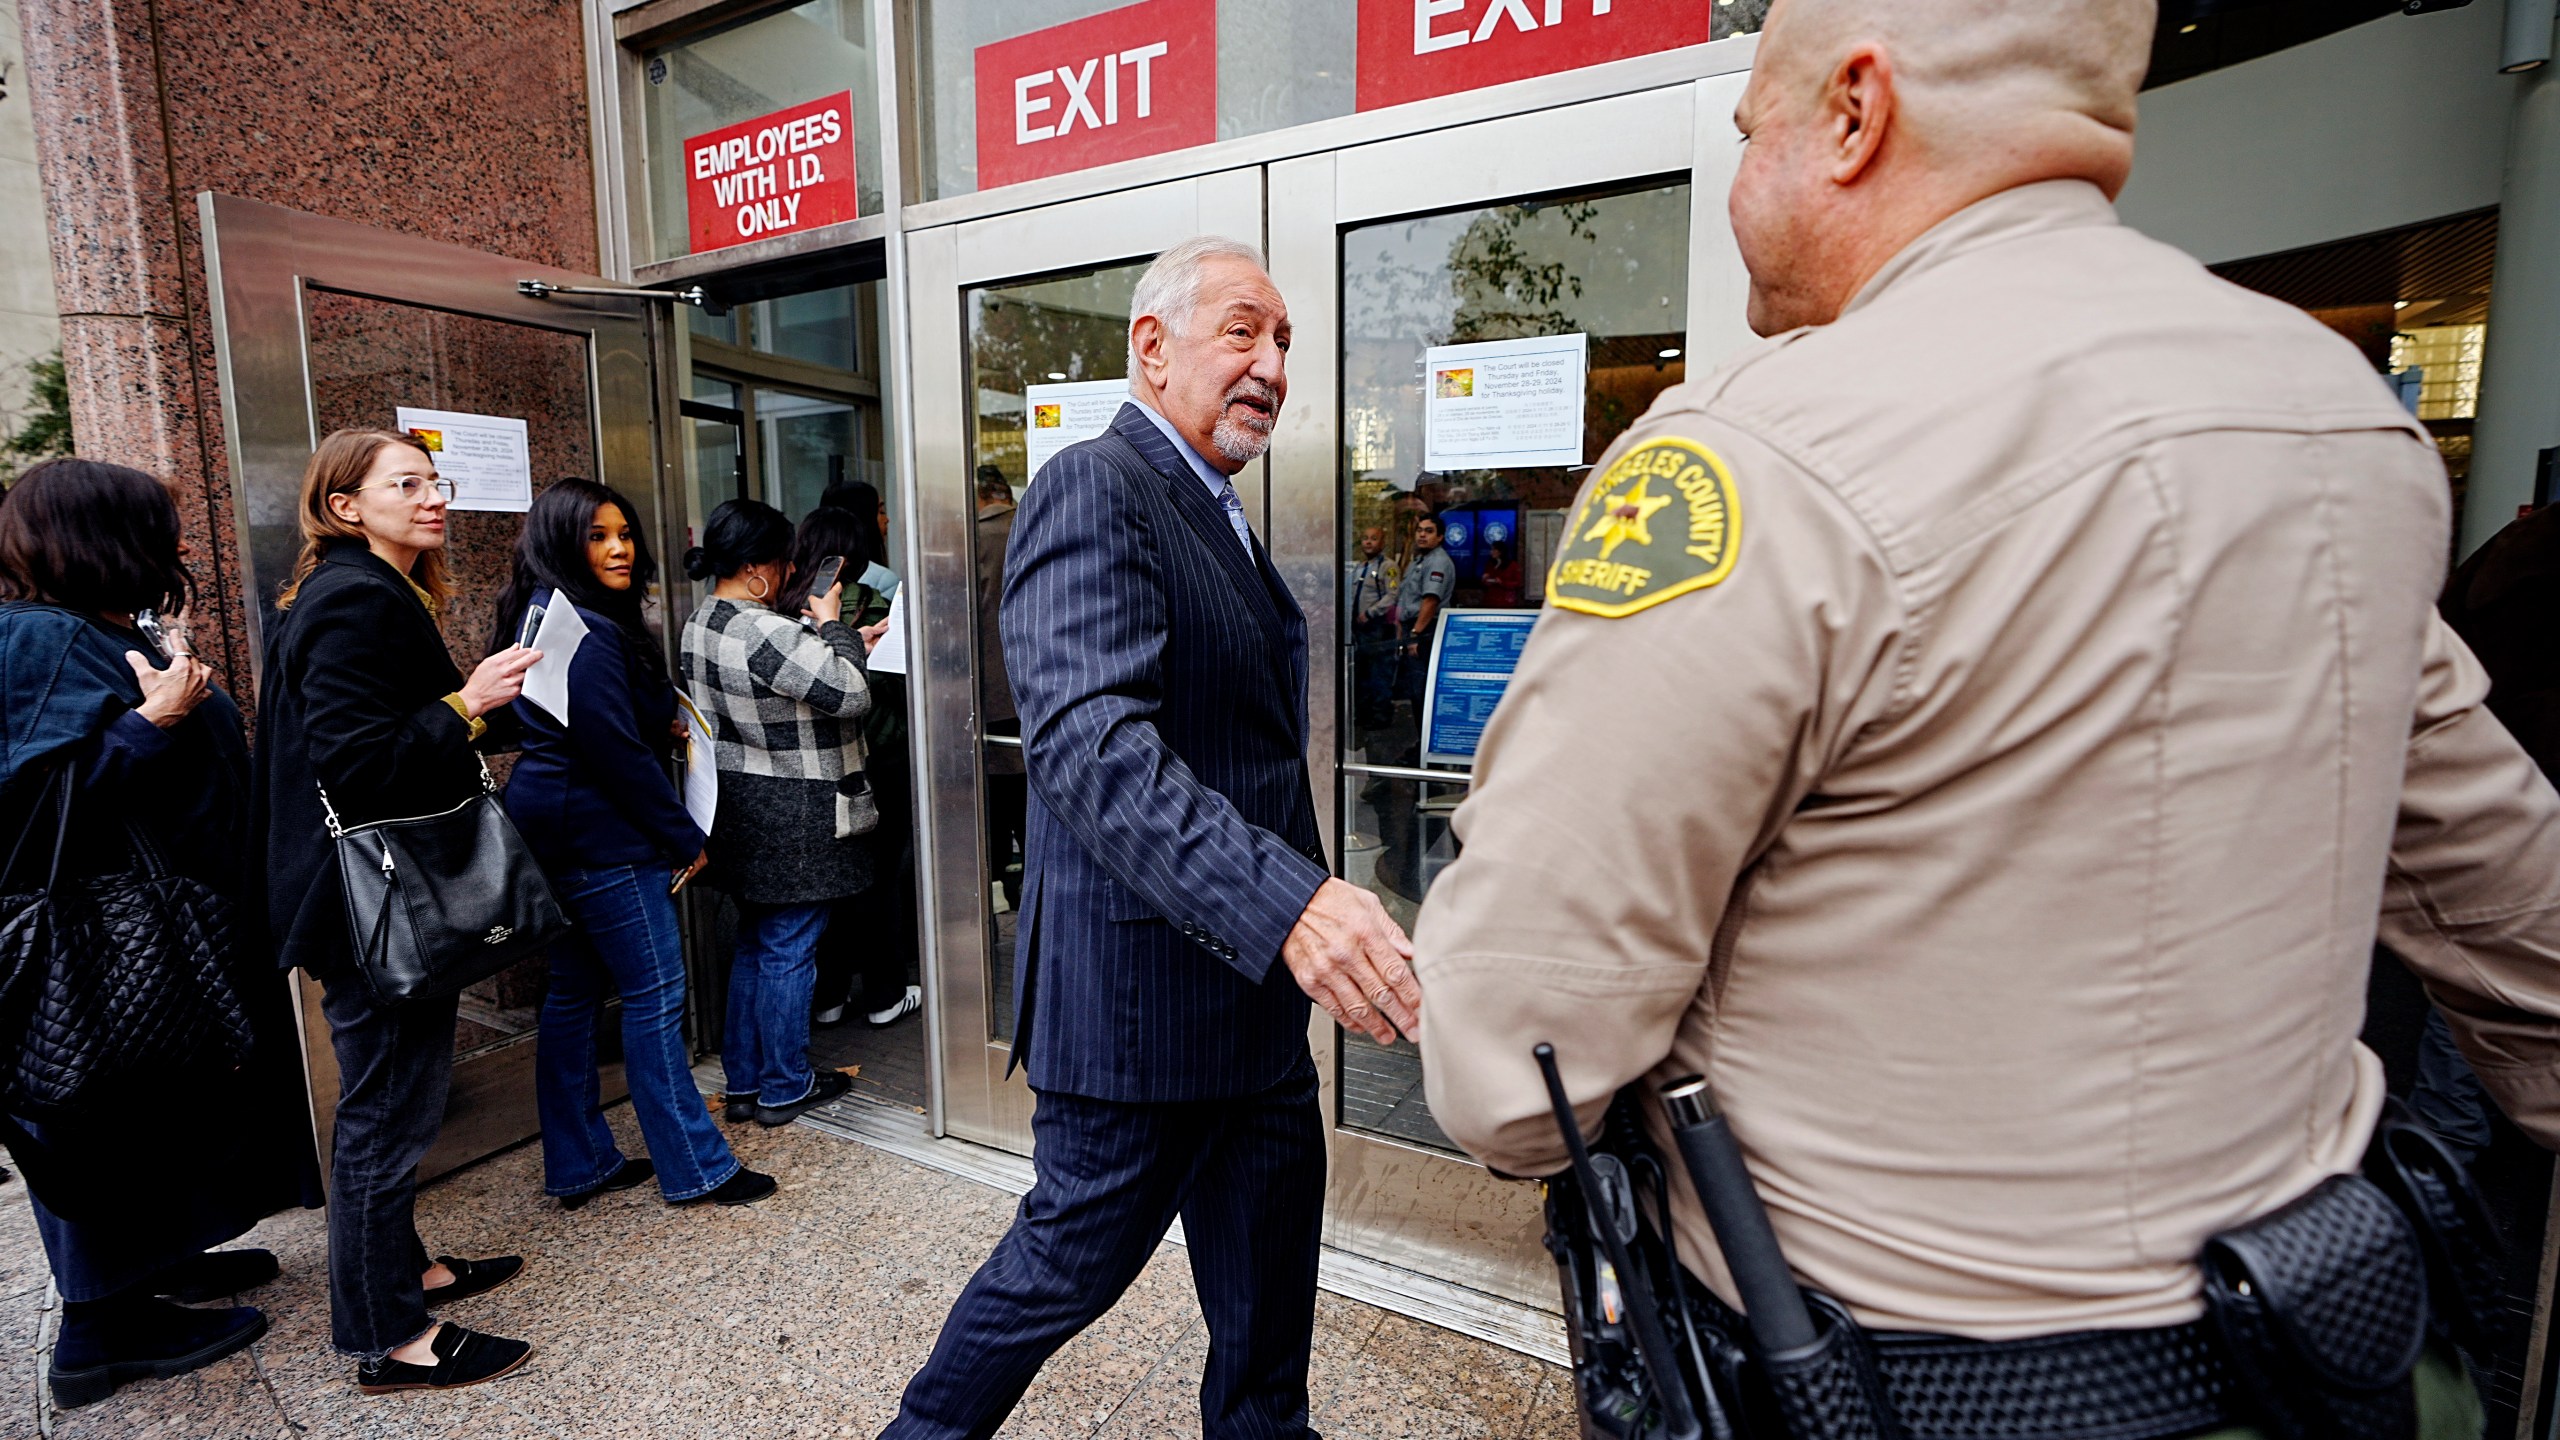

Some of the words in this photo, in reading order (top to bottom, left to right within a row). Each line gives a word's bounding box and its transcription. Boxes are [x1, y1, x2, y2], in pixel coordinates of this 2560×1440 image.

[1015, 41, 1167, 145] EXIT
[694, 109, 841, 180] EMPLOYEES
[712, 163, 776, 208] WITH
[787, 153, 825, 190] I.D.
[736, 192, 800, 237] ONLY
[1484, 381, 1519, 389] November
[1545, 377, 1562, 385] 2024
[1488, 373, 1519, 381] Thursday
[1498, 363, 1517, 371] Court
[1542, 359, 1565, 367] closed
[1493, 389, 1537, 398] Thanksgiving
[1674, 464, 1724, 565] COUNTY
[1556, 558, 1653, 597] SHERIFF
